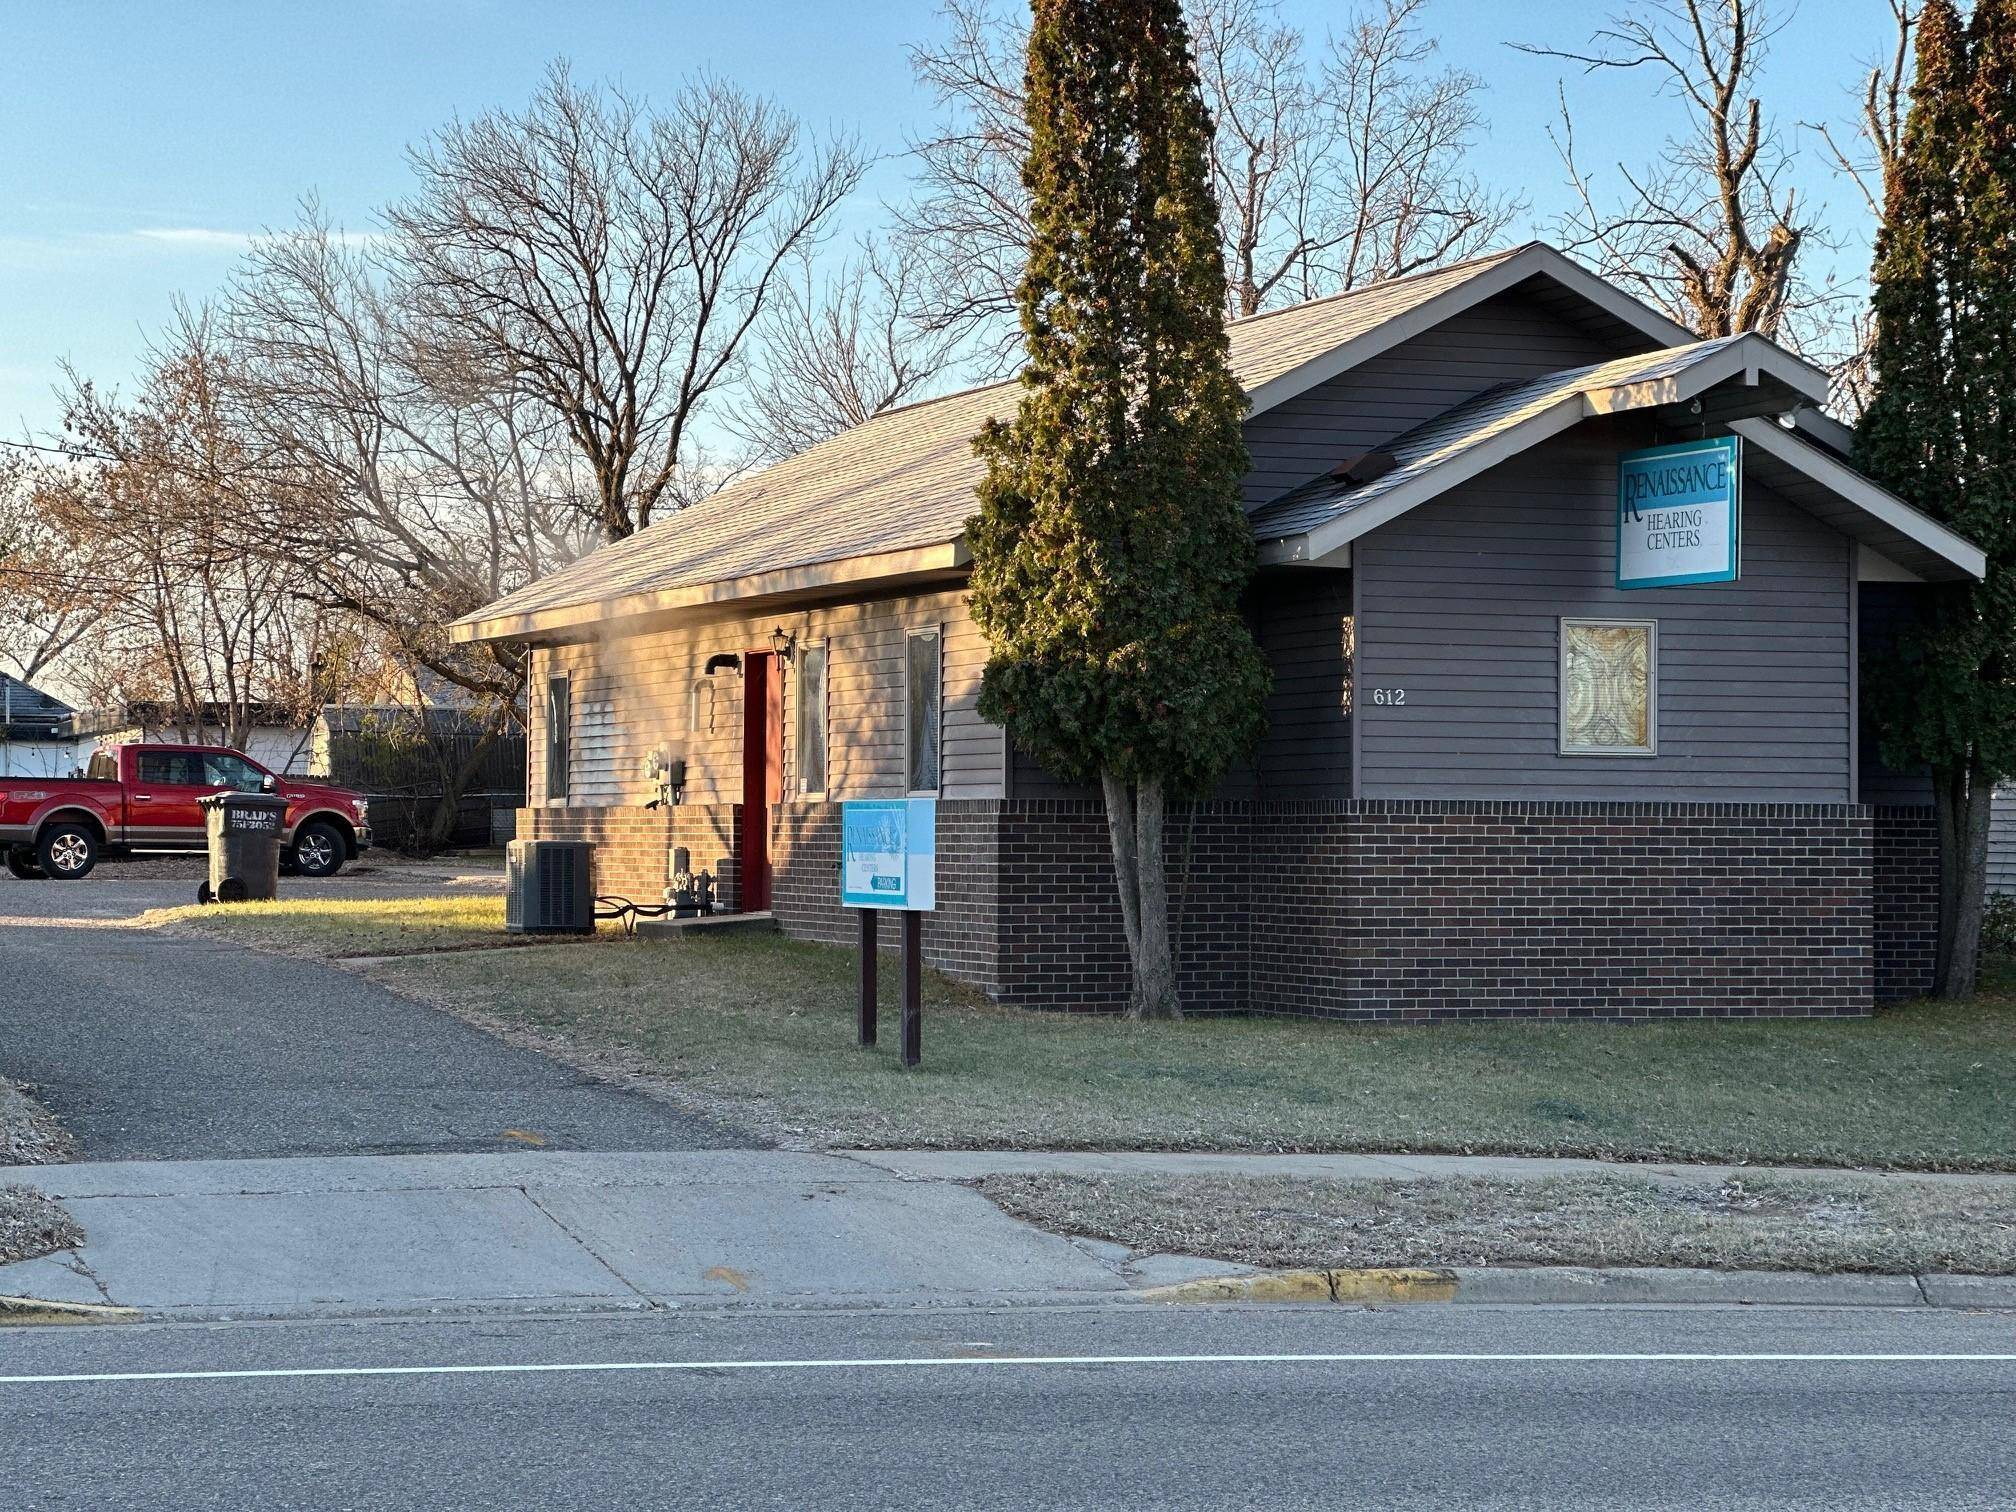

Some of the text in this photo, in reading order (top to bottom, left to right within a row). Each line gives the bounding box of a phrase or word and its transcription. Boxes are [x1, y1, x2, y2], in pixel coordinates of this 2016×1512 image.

[1623, 461, 1726, 523] RENAISSANCE
[1647, 510, 1702, 531] HEARING
[1647, 529, 1700, 550] CENTERS
[1373, 688, 1406, 705] 612
[231, 809, 277, 821] BRAD'S
